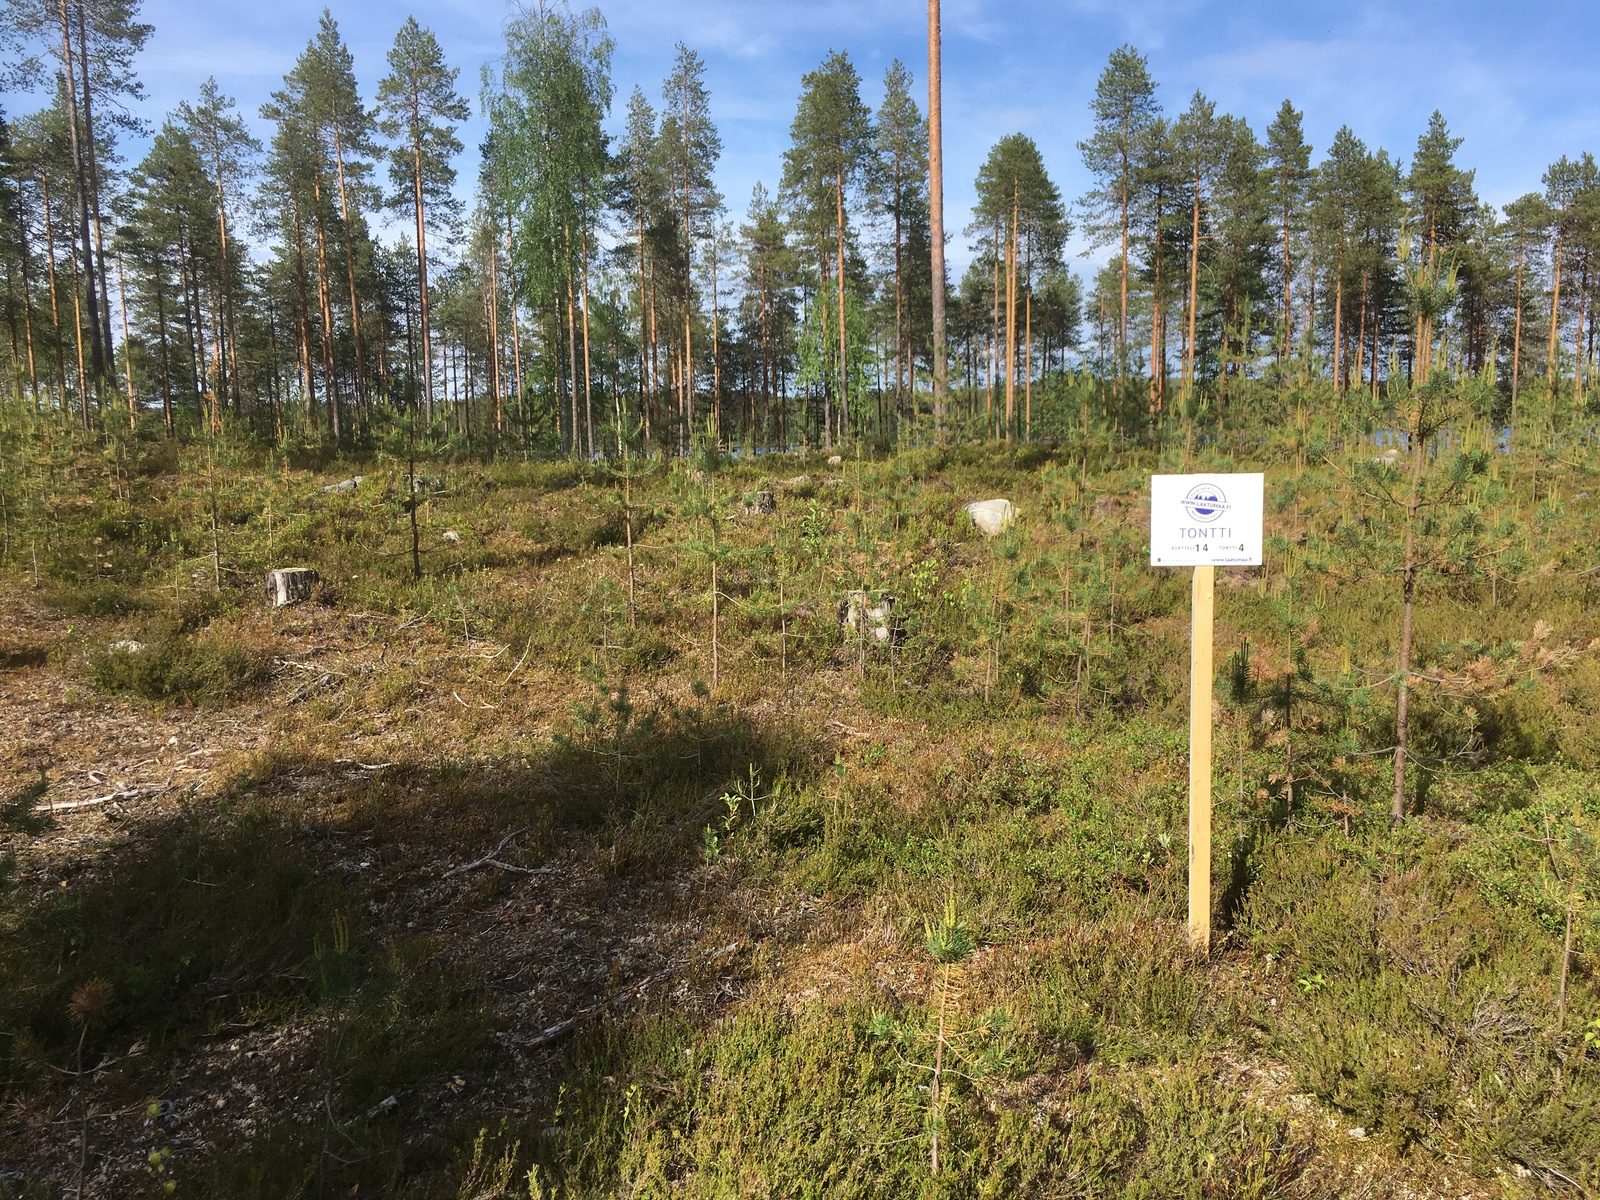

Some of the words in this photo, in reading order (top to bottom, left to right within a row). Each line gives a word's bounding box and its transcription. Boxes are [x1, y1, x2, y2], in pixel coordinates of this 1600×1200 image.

[1179, 527, 1232, 539] TONTTI
[1195, 543, 1209, 553] 14
[1238, 543, 1245, 553] 4
